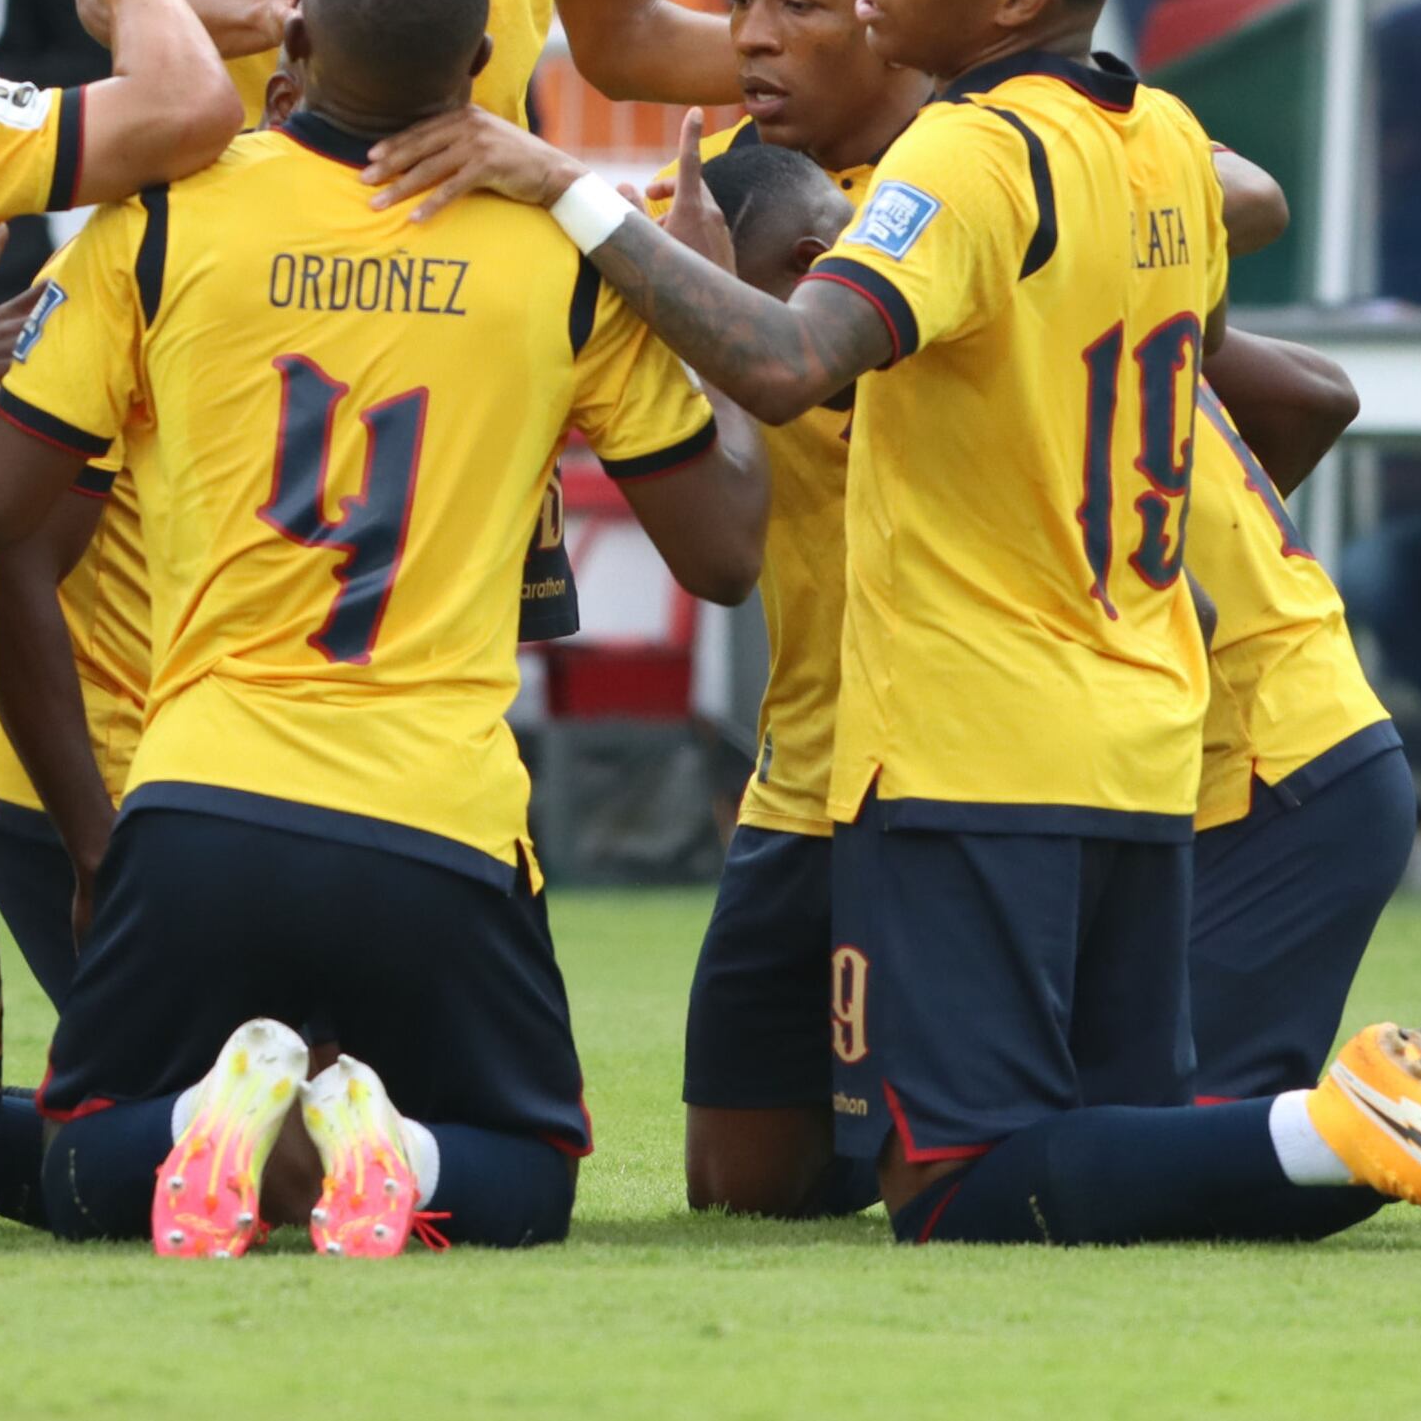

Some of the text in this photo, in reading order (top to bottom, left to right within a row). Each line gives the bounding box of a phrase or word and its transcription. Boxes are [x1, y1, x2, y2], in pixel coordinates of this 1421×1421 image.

[1130, 207, 1189, 269] LATA
[269, 249, 469, 316] ORDOÑEZ
[1076, 310, 1201, 620] 19
[256, 353, 429, 665] 4
[521, 577, 566, 599] arathon
